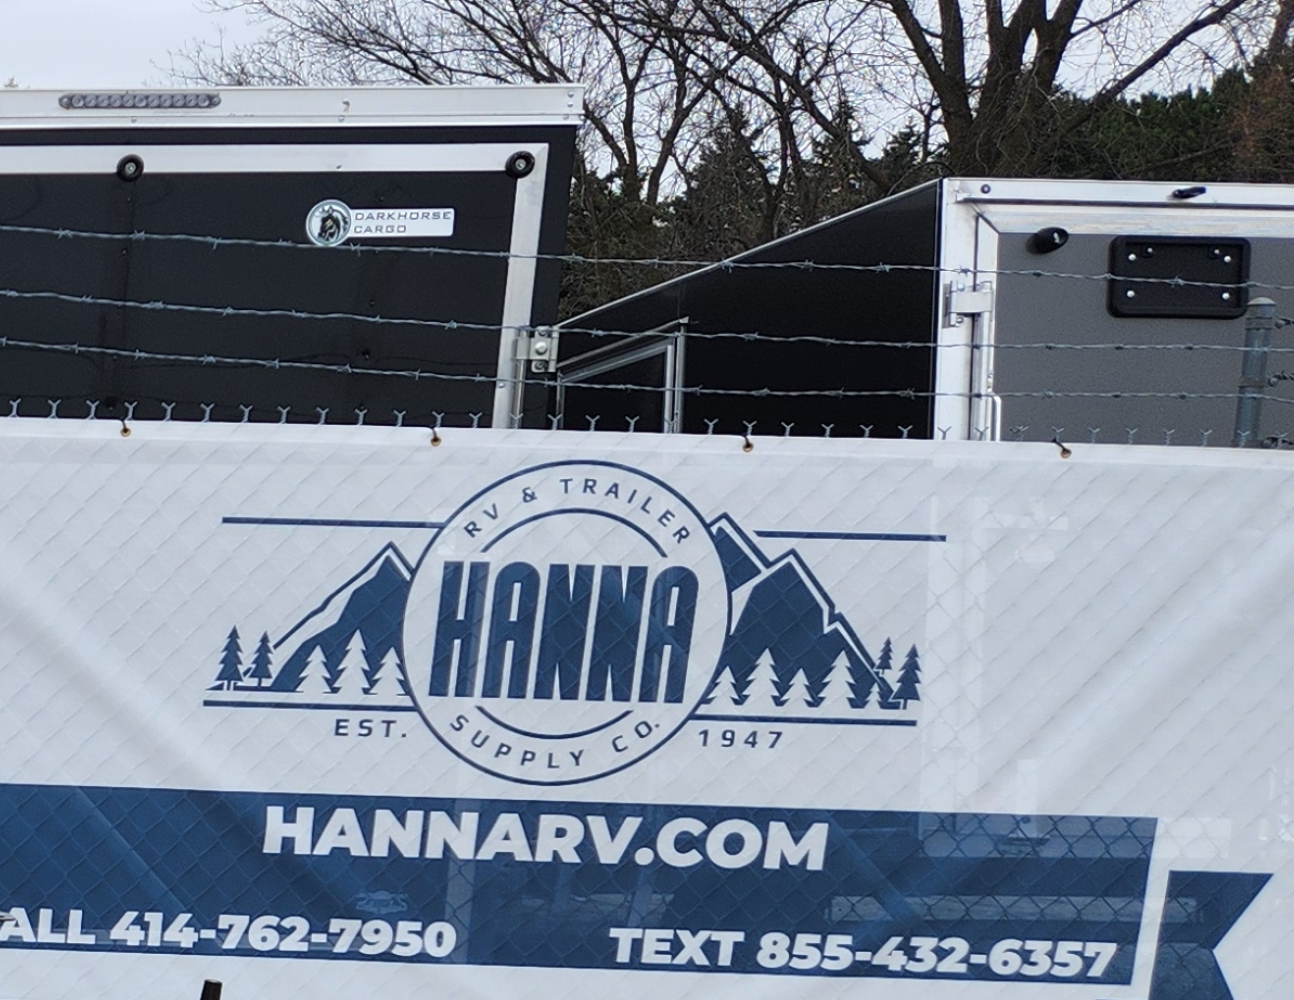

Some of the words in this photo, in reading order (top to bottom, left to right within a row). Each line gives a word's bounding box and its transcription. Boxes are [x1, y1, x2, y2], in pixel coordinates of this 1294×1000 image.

[353, 225, 407, 234] CARGO
[354, 211, 452, 221] DARKHORSE
[463, 503, 500, 538] RV
[522, 486, 538, 504] &
[559, 478, 691, 544] TRAILER
[428, 561, 699, 703] HANNA
[334, 718, 408, 739] EST.
[450, 713, 584, 770] SUPPLY
[612, 720, 661, 754] CO.
[697, 729, 783, 750] 1947
[262, 805, 830, 871] HANNARV.COM
[109, 911, 458, 958] 414-762-7950
[609, 927, 745, 967] TEXT
[756, 931, 1118, 978] 855-432-6357
